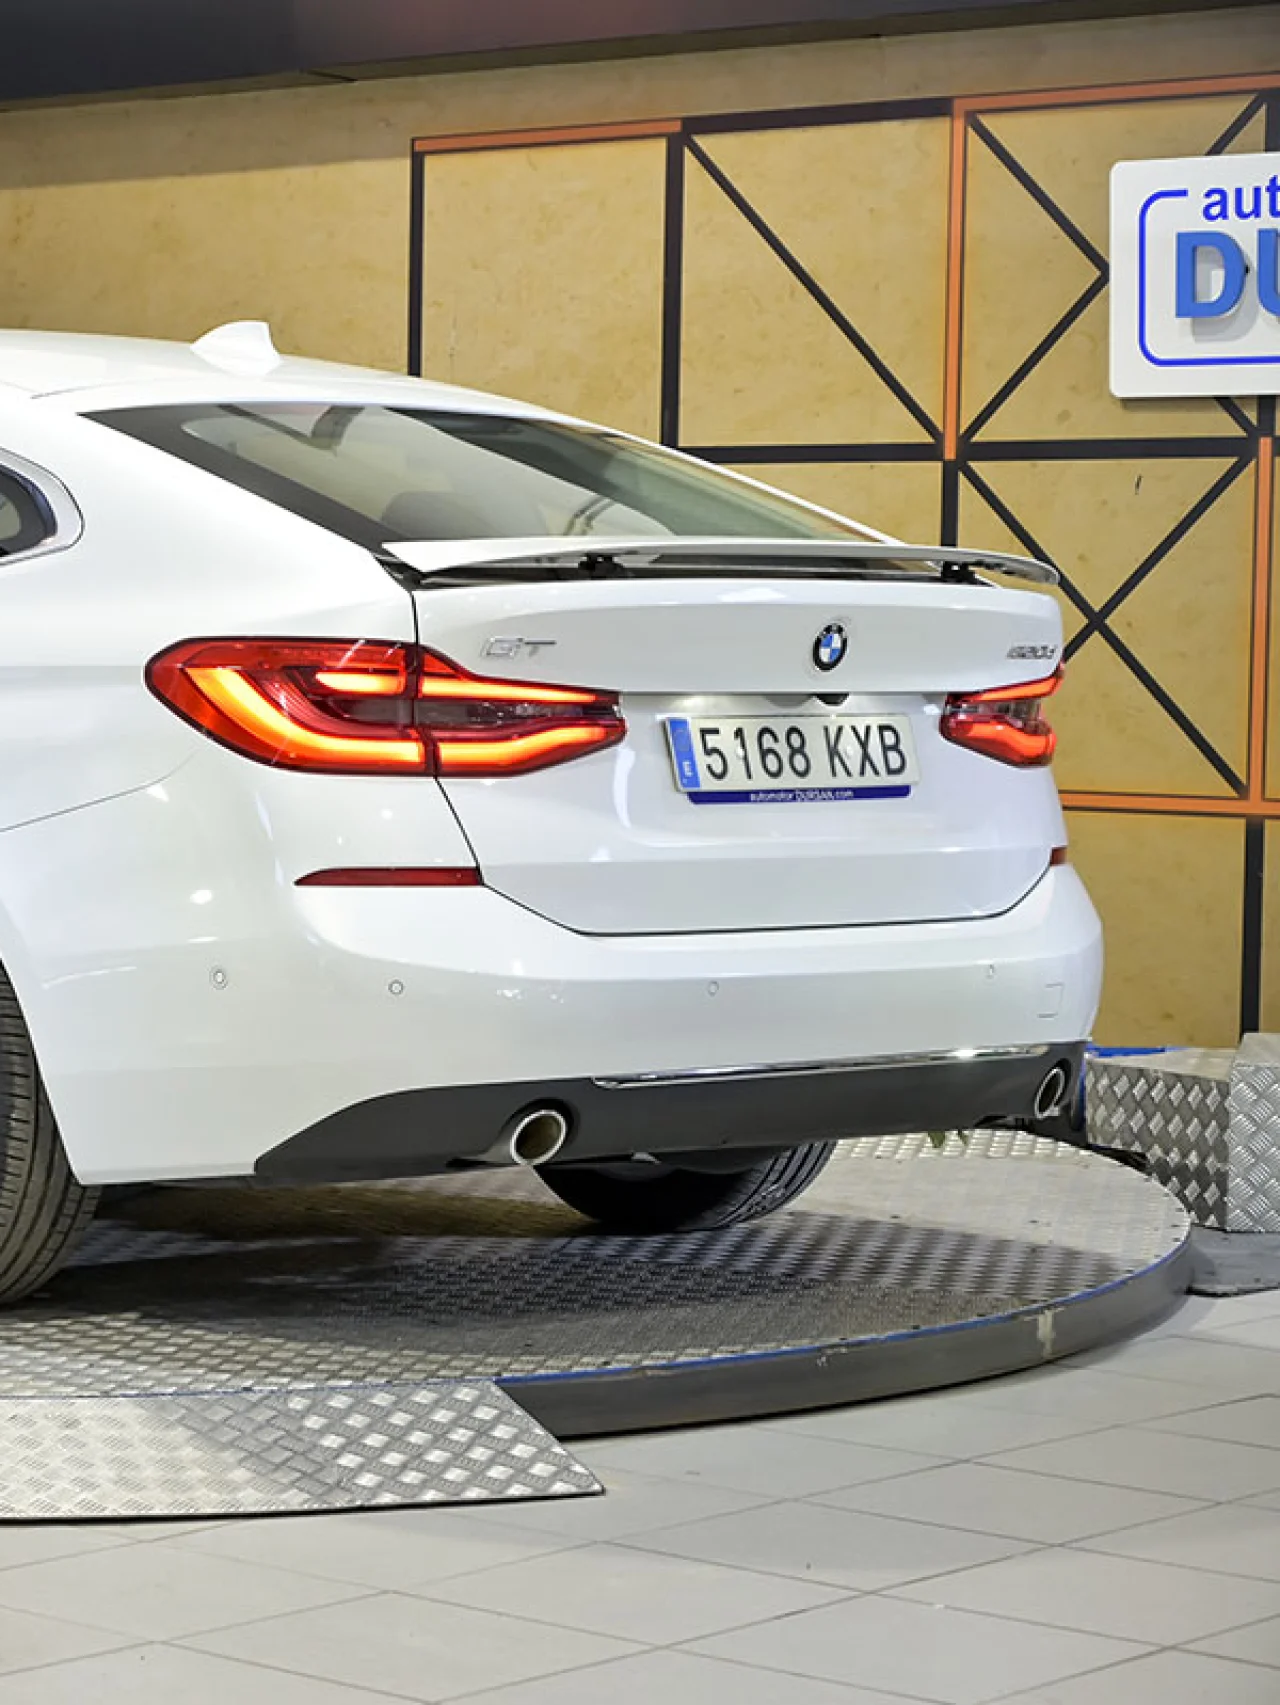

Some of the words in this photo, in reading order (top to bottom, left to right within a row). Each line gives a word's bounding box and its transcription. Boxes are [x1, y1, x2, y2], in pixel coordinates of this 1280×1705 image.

[480, 636, 557, 660] GT
[699, 725, 812, 780] 5168
[823, 724, 907, 778] KXB
